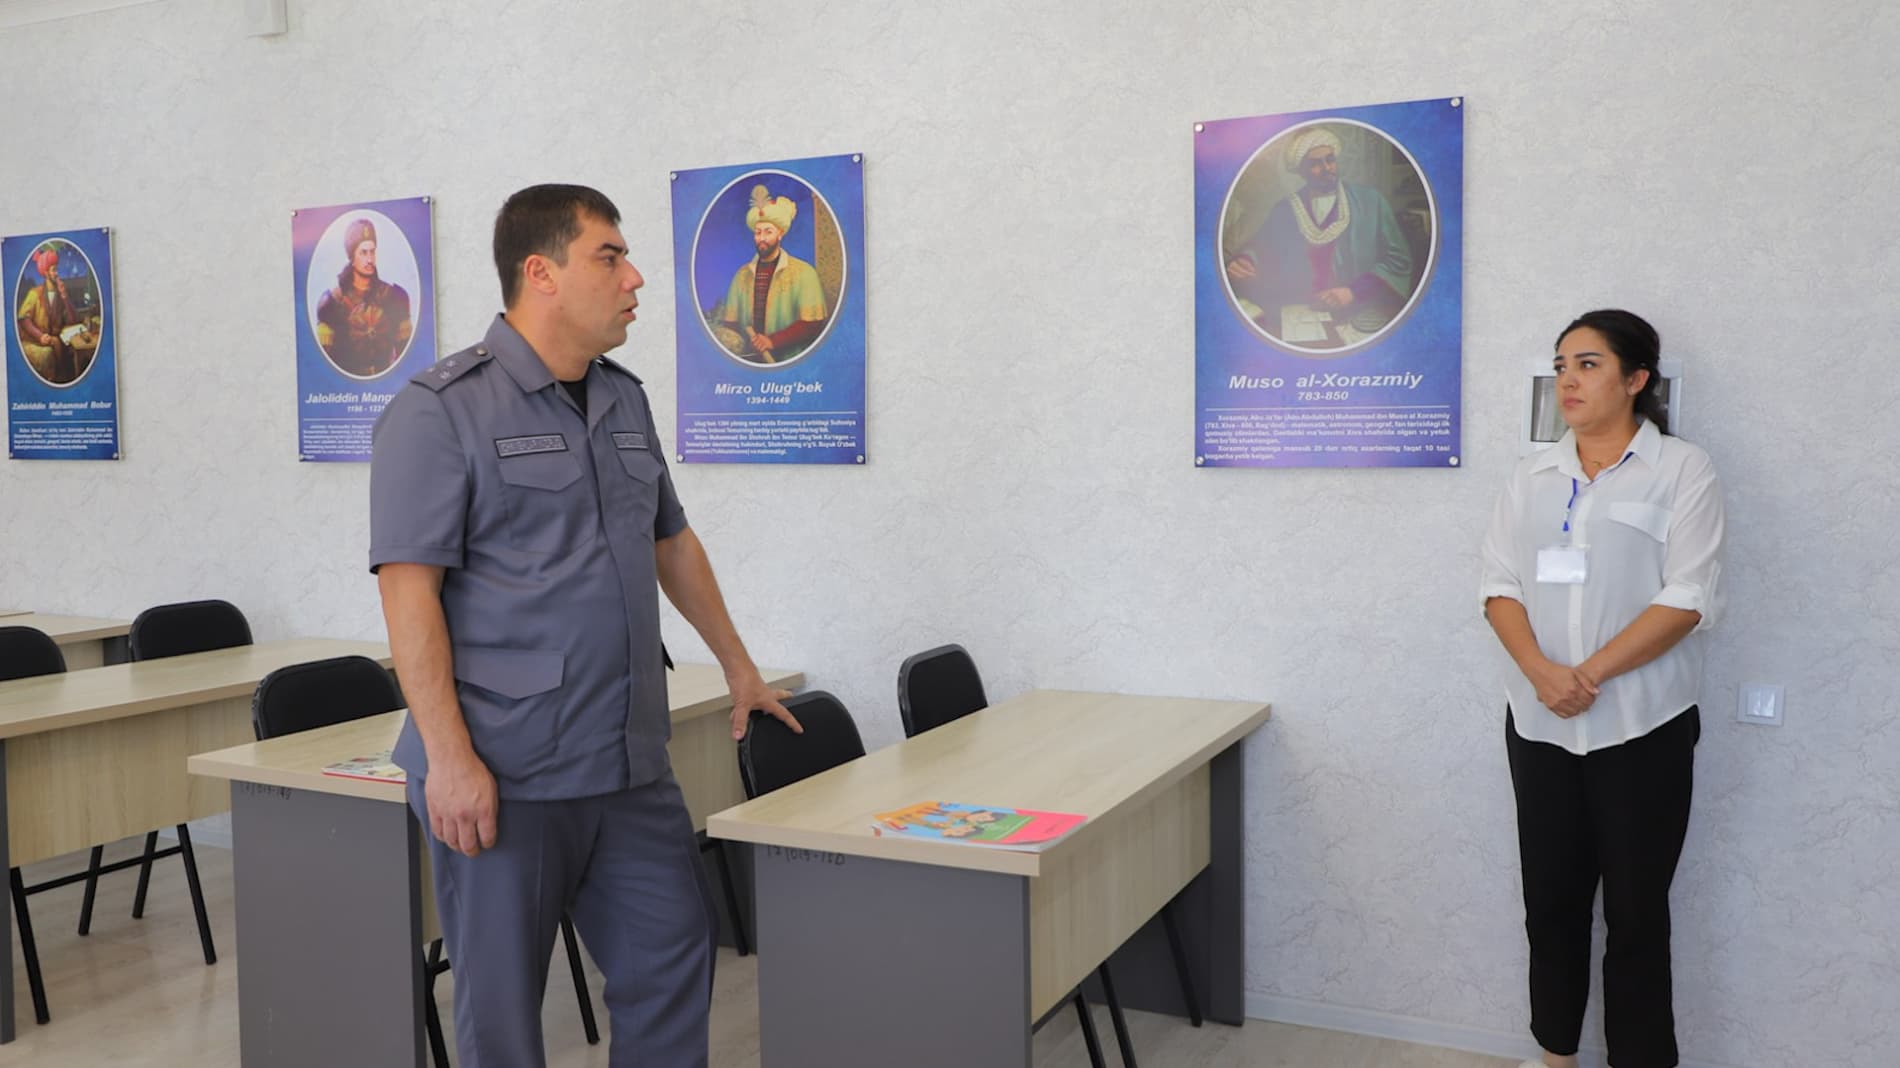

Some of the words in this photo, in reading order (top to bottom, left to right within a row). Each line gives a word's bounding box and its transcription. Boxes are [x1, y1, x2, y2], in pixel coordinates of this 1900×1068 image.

[1229, 375, 1284, 389] Muso
[1296, 372, 1423, 389] al-Xorazmiy
[715, 383, 752, 394] Mirzo
[760, 381, 823, 395] Ulug'bek
[305, 393, 358, 403] Jaloliddin
[746, 395, 791, 405] 1394-1449
[1297, 391, 1349, 401] 783-850
[49, 401, 88, 409] Muhammad
[91, 401, 112, 409] Bobur
